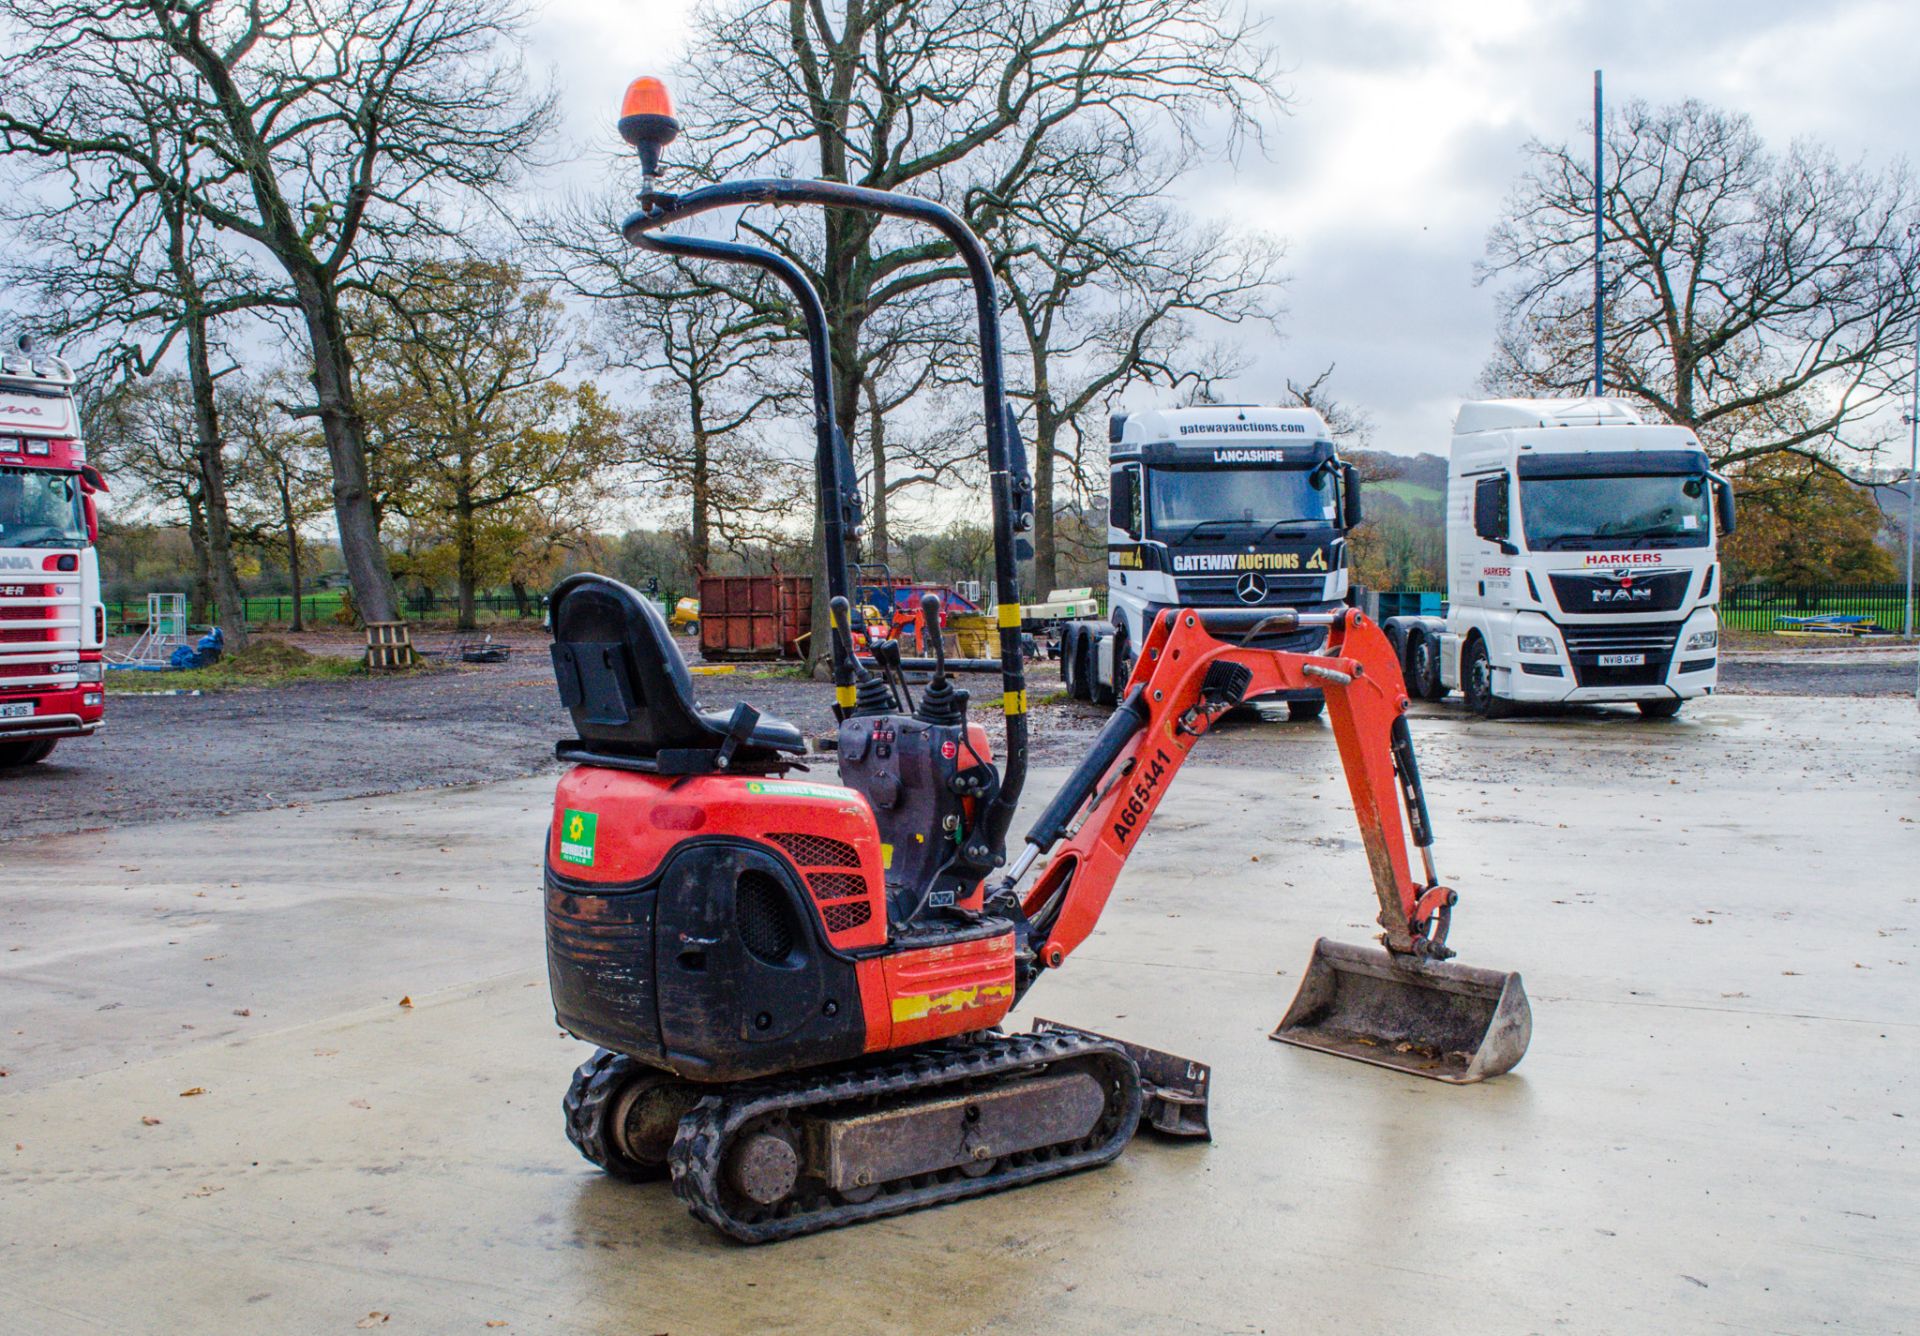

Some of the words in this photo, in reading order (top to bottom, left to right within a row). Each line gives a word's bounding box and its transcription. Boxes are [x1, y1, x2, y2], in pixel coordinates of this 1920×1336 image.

[1180, 422, 1305, 435] gatewayauctions.com
[1213, 450, 1284, 462] LANCASHIRE
[1586, 553, 1662, 564] HARKERS
[1484, 567, 1511, 577] HARKERS
[1592, 588, 1652, 602] MAN
[1113, 748, 1171, 845] A665441
